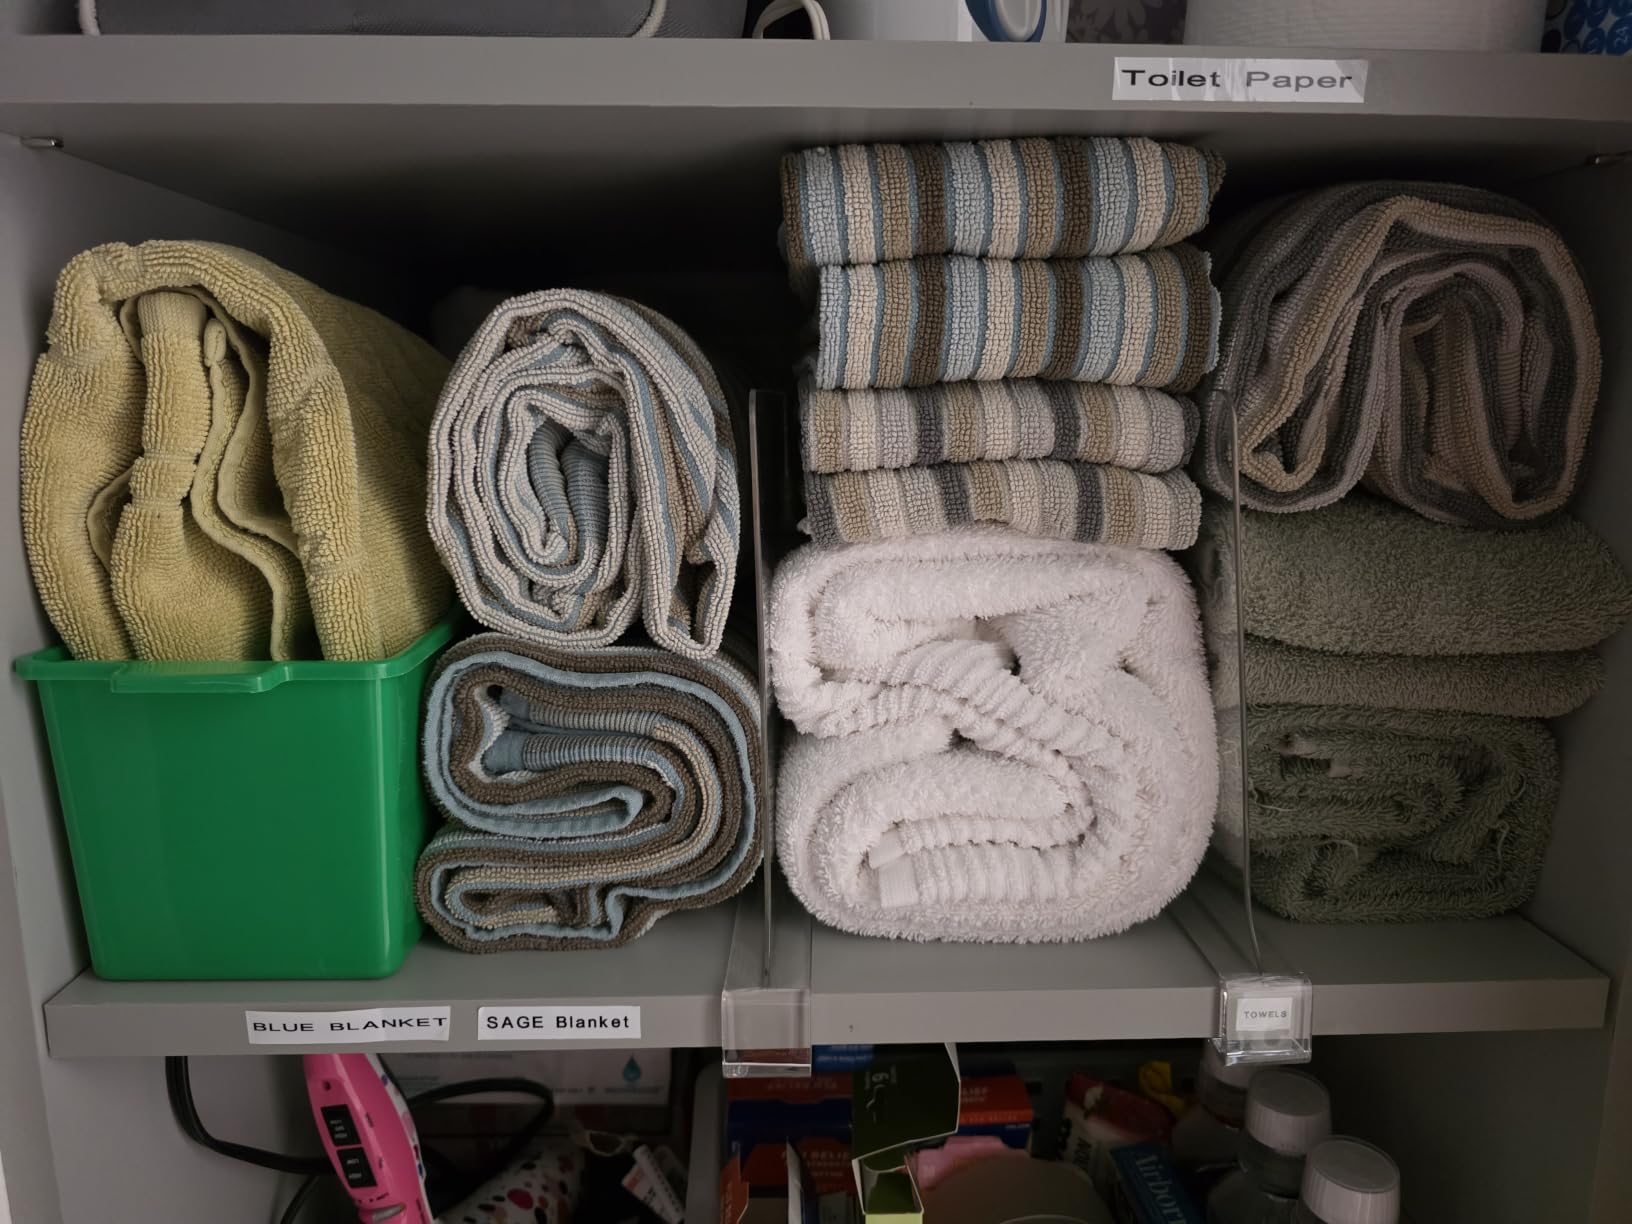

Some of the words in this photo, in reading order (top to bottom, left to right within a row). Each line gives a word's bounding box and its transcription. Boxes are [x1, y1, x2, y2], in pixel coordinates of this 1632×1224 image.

[1121, 69, 1221, 88] Toilet
[1246, 71, 1353, 92] Paper
[486, 1015, 544, 1029] SAGE
[555, 1014, 629, 1029] Blanket
[1243, 1010, 1288, 1019] TOWELS
[252, 1021, 314, 1032] BLUE
[330, 1017, 447, 1032] BLANKET
